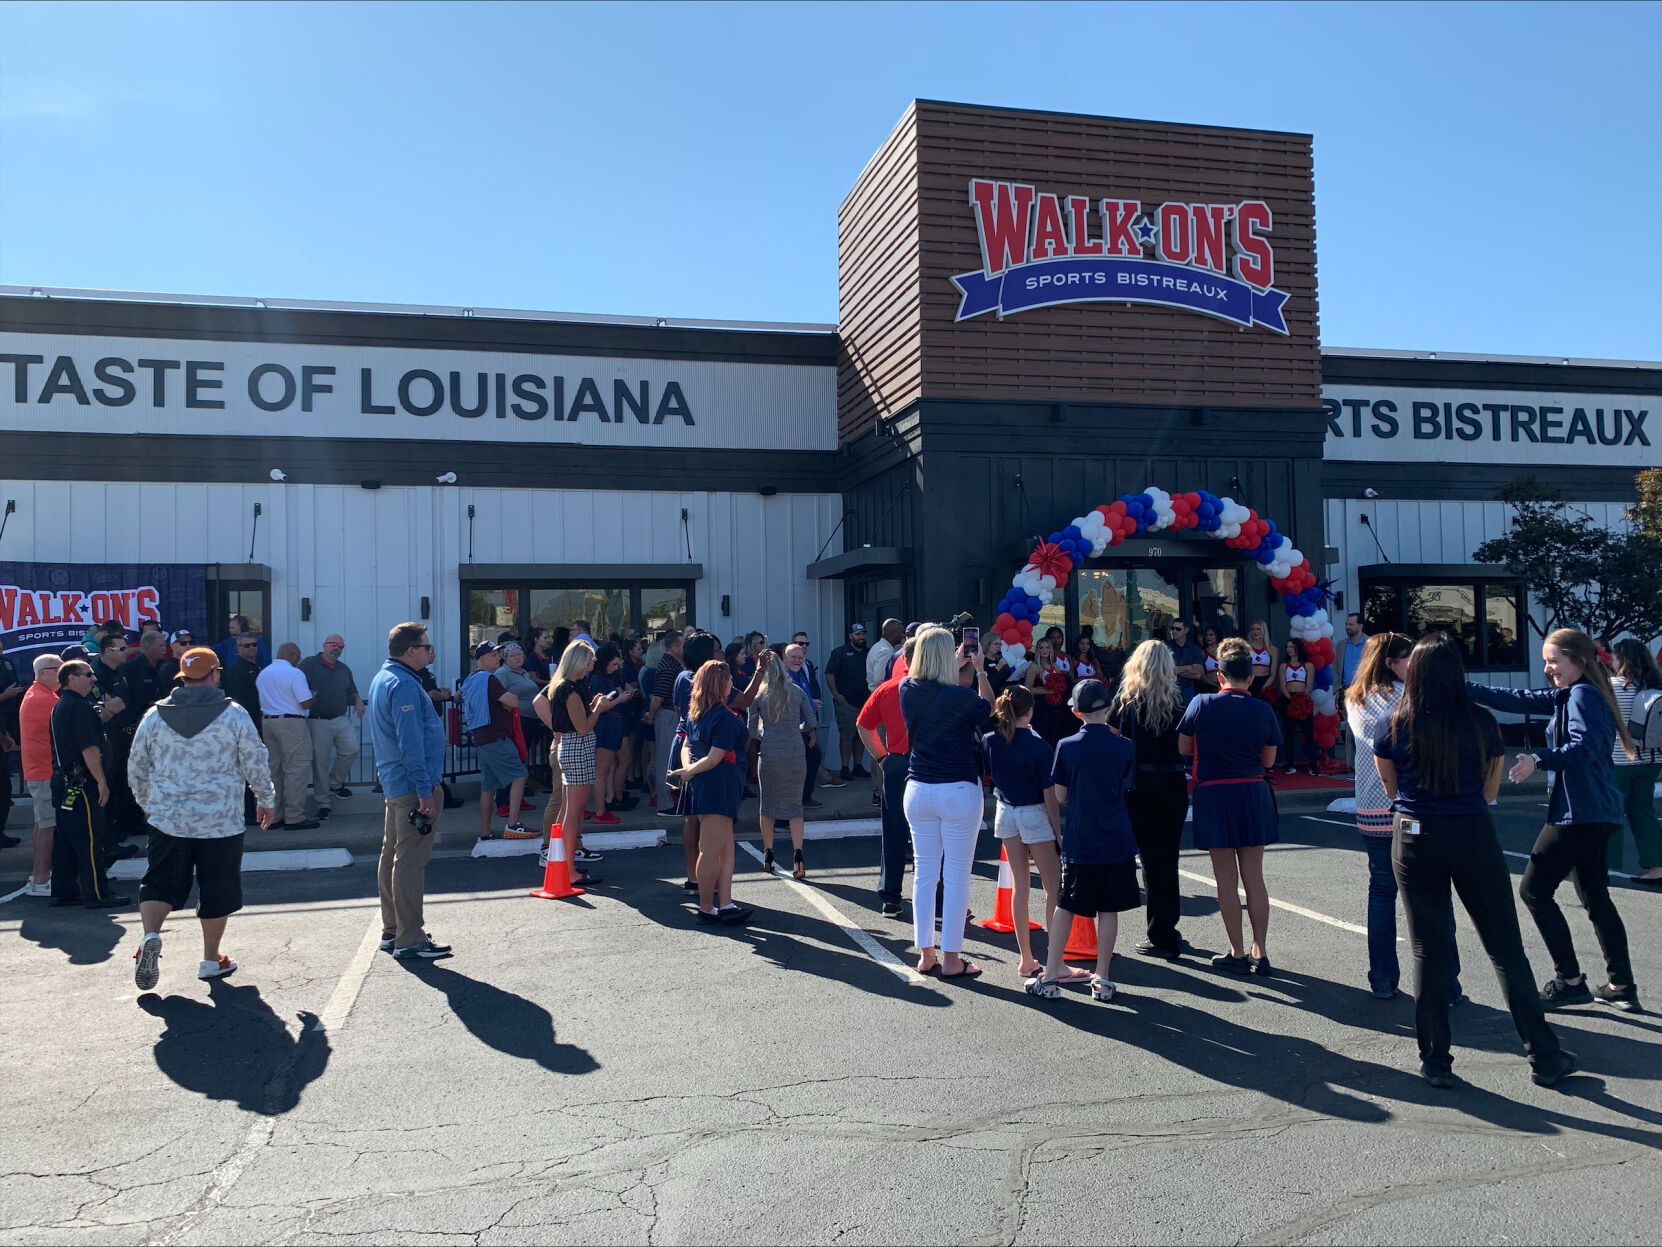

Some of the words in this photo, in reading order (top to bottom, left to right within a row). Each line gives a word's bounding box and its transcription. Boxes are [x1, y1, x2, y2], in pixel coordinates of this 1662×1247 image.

[1025, 272, 1106, 290] SPORTS
[1117, 273, 1230, 302] BISTREAUX
[0, 354, 225, 409] TASTE
[248, 363, 337, 412] OF
[361, 367, 695, 426] LOUISIANA
[1412, 401, 1651, 446] BISTREAUX
[1149, 547, 1162, 557] 970
[18, 630, 65, 641] SPORTS
